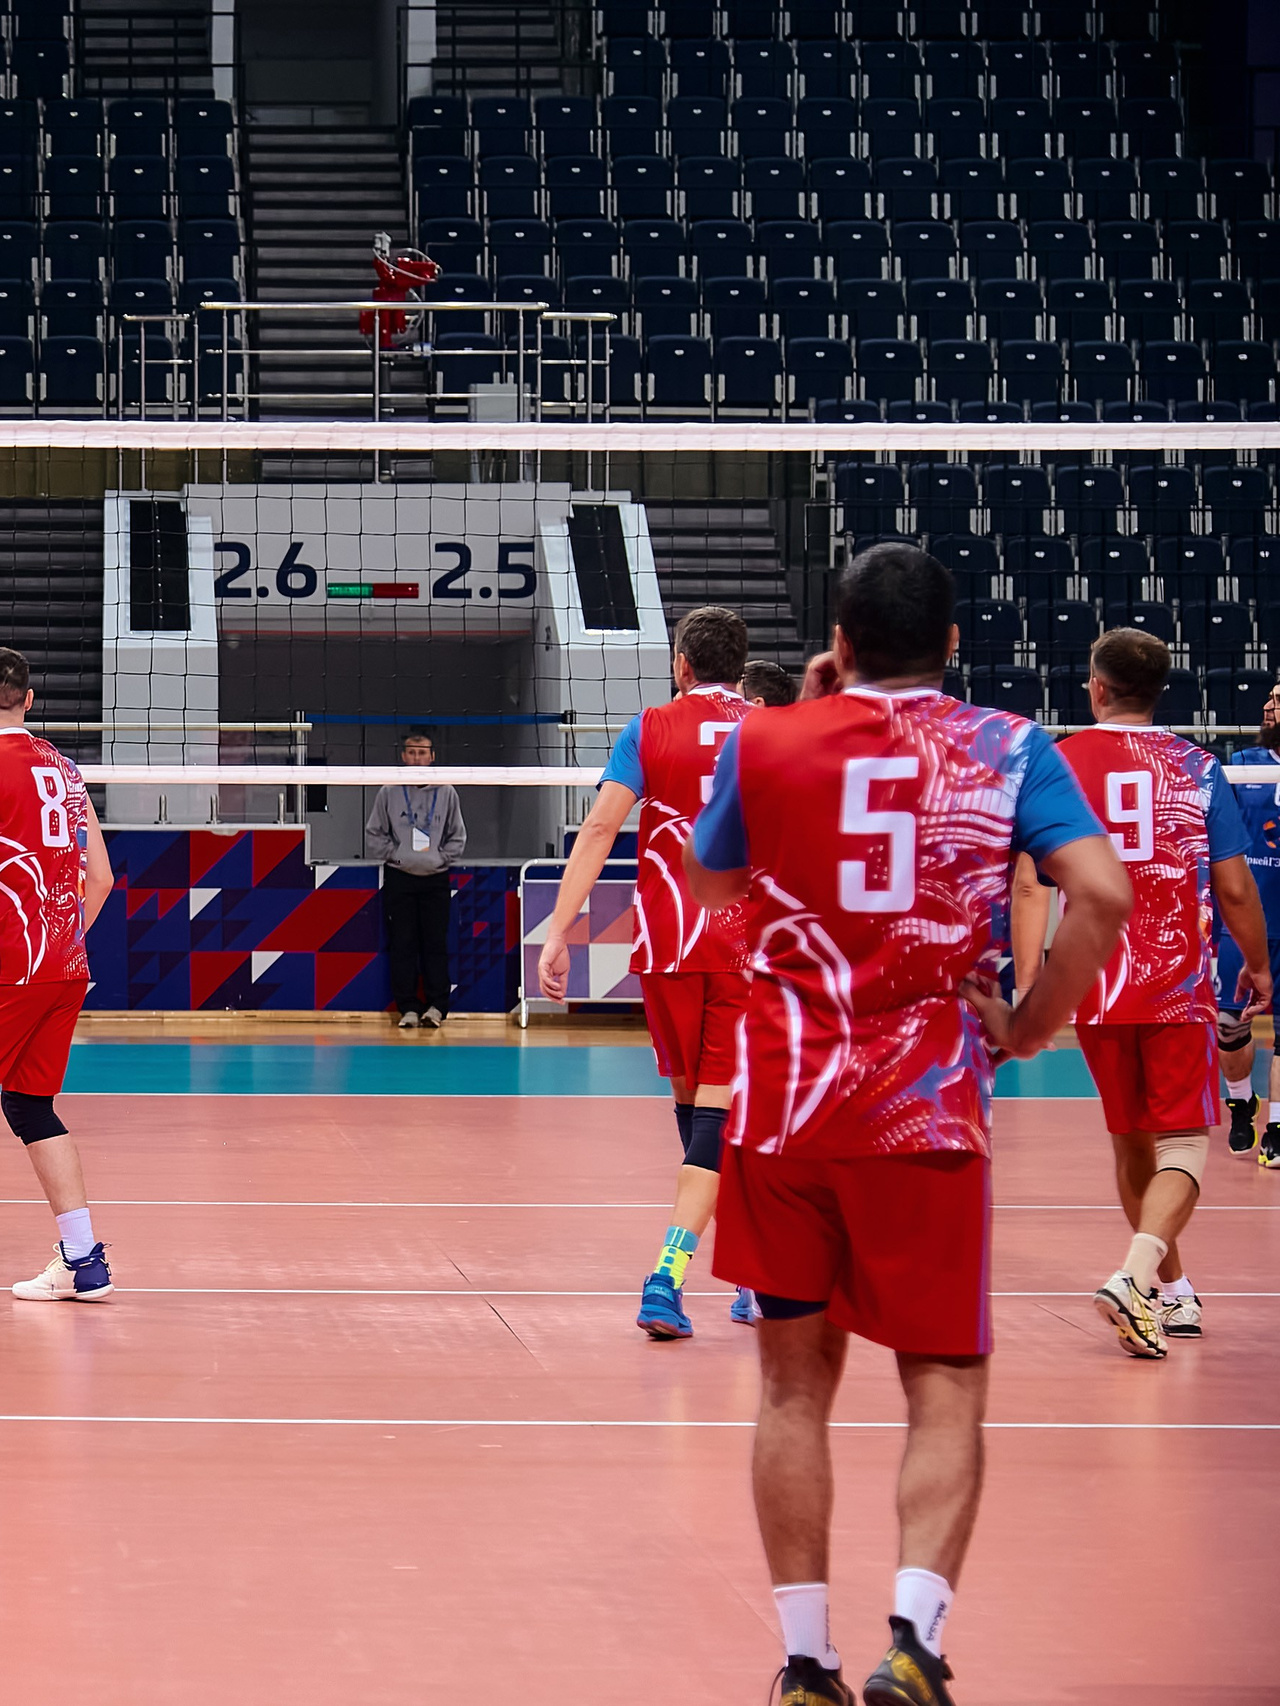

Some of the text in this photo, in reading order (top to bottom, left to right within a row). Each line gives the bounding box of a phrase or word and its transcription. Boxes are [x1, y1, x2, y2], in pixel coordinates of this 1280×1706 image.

[214, 541, 317, 599] 2.6
[432, 542, 537, 599] 2.5
[31, 766, 71, 848] 8
[839, 757, 919, 913] 5
[1105, 770, 1154, 862] 9
